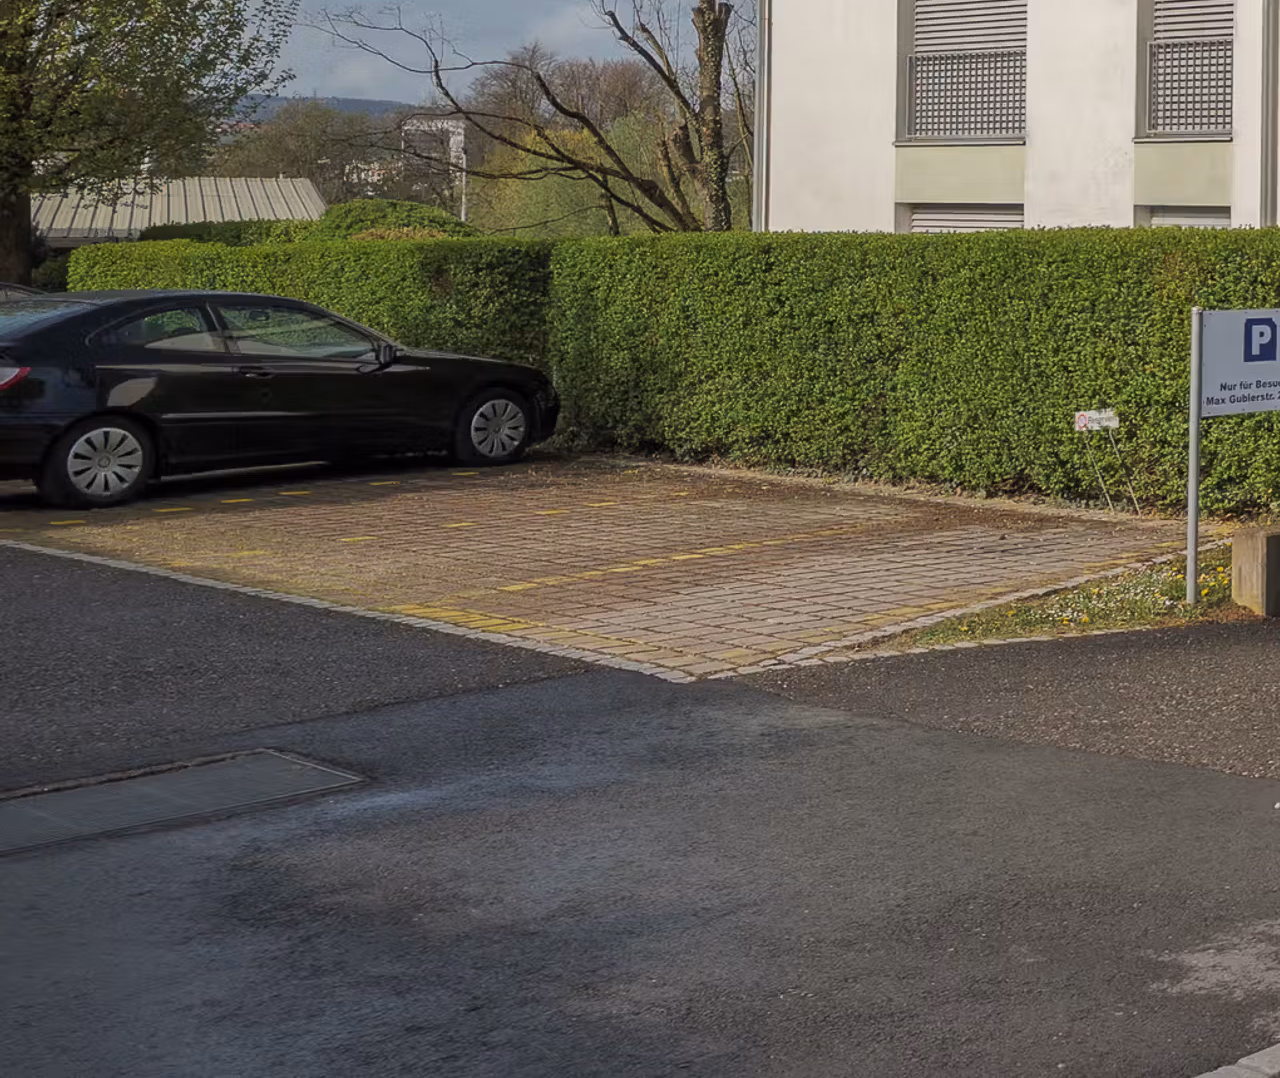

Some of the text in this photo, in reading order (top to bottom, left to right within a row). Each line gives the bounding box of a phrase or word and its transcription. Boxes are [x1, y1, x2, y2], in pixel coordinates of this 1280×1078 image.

[1251, 324, 1272, 355] P
[1220, 382, 1237, 391] Nur
[1240, 381, 1253, 390] für
[1206, 396, 1226, 406] Max
